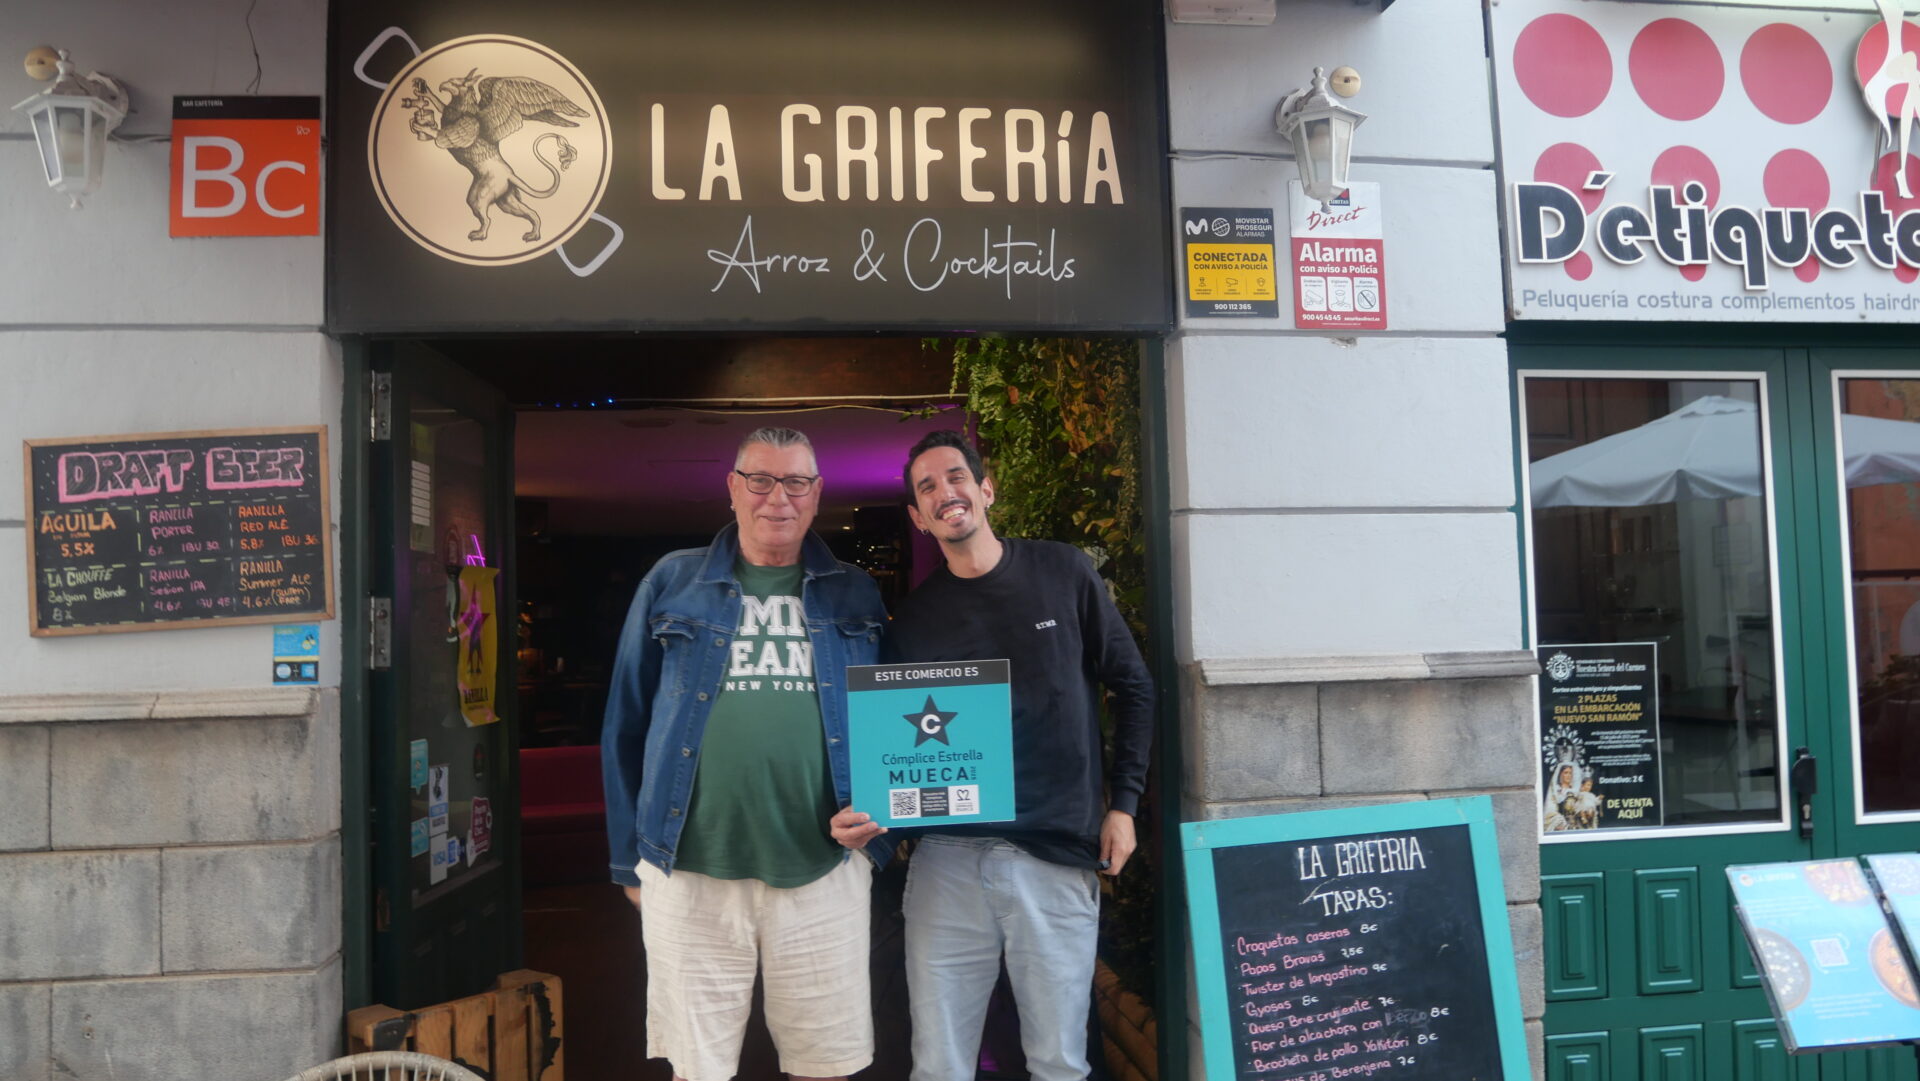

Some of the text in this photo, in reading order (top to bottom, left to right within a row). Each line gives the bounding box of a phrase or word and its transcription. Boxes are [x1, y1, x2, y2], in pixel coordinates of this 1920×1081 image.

[651, 103, 1124, 204] LA GRIFERÍA
[182, 136, 306, 218] Bc
[1307, 206, 1367, 231] Direct
[707, 215, 1076, 299] Arroz & Cocktails
[1194, 252, 1267, 262] CONECTADA
[1300, 242, 1377, 263] Alarma
[1241, 262, 1268, 270] POLICÍA
[1318, 264, 1340, 273] aviso
[1349, 264, 1378, 274] Policía
[1522, 289, 1629, 312] Peluquería
[1637, 290, 1713, 309] costura
[1721, 292, 1856, 313] complementos
[59, 447, 304, 503] DRAFT BEER
[149, 507, 194, 524] RANILLA
[239, 504, 286, 518] RANILLA
[151, 525, 195, 540] PORTER
[240, 518, 289, 533] RED ALE
[150, 569, 190, 582] RANILLA
[240, 560, 284, 577] RANILLA
[47, 568, 114, 589] LA CHOUFFE
[190, 580, 207, 592] IPA
[874, 666, 979, 682] ESTE COMERCIO ES
[725, 680, 816, 692] NEW YORK
[1578, 694, 1618, 703] 2 PLAZAS
[1554, 702, 1641, 714] EN LA EMBARCACIÓN
[920, 713, 941, 735] C
[1588, 714, 1605, 723] SAN
[882, 749, 983, 767] Cómplice Estrella
[889, 766, 969, 785] MUECA
[1632, 775, 1638, 783] 2
[1638, 775, 1644, 783] €
[1607, 797, 1654, 808] DE VENTA
[1618, 807, 1643, 819] AQUÍ
[1298, 836, 1427, 881] LA GRIFERIA
[1313, 886, 1394, 917] TAPAS:
[1237, 923, 1378, 957] Croquetas caseras 8€
[1283, 952, 1326, 970] Bravas
[1241, 963, 1388, 997] Twister de langostino 9€
[1245, 995, 1319, 1018] Gyosas 8€
[1249, 1020, 1285, 1035] Queso
[1288, 1014, 1314, 1028] Brie
[1378, 996, 1395, 1007] 7€
[1251, 1040, 1276, 1053] Flor
[1279, 1035, 1295, 1047] de
[1362, 1019, 1383, 1032] con
[1430, 1007, 1450, 1018] 8€
[1254, 1053, 1310, 1073] Brocheta
[1313, 1047, 1330, 1062] de
[1331, 1041, 1359, 1060] pollo
[1417, 1032, 1439, 1045] 8€
[1309, 1070, 1328, 1081] de
[1332, 1059, 1392, 1078] Berenjena
[1397, 1056, 1416, 1066] 7€
